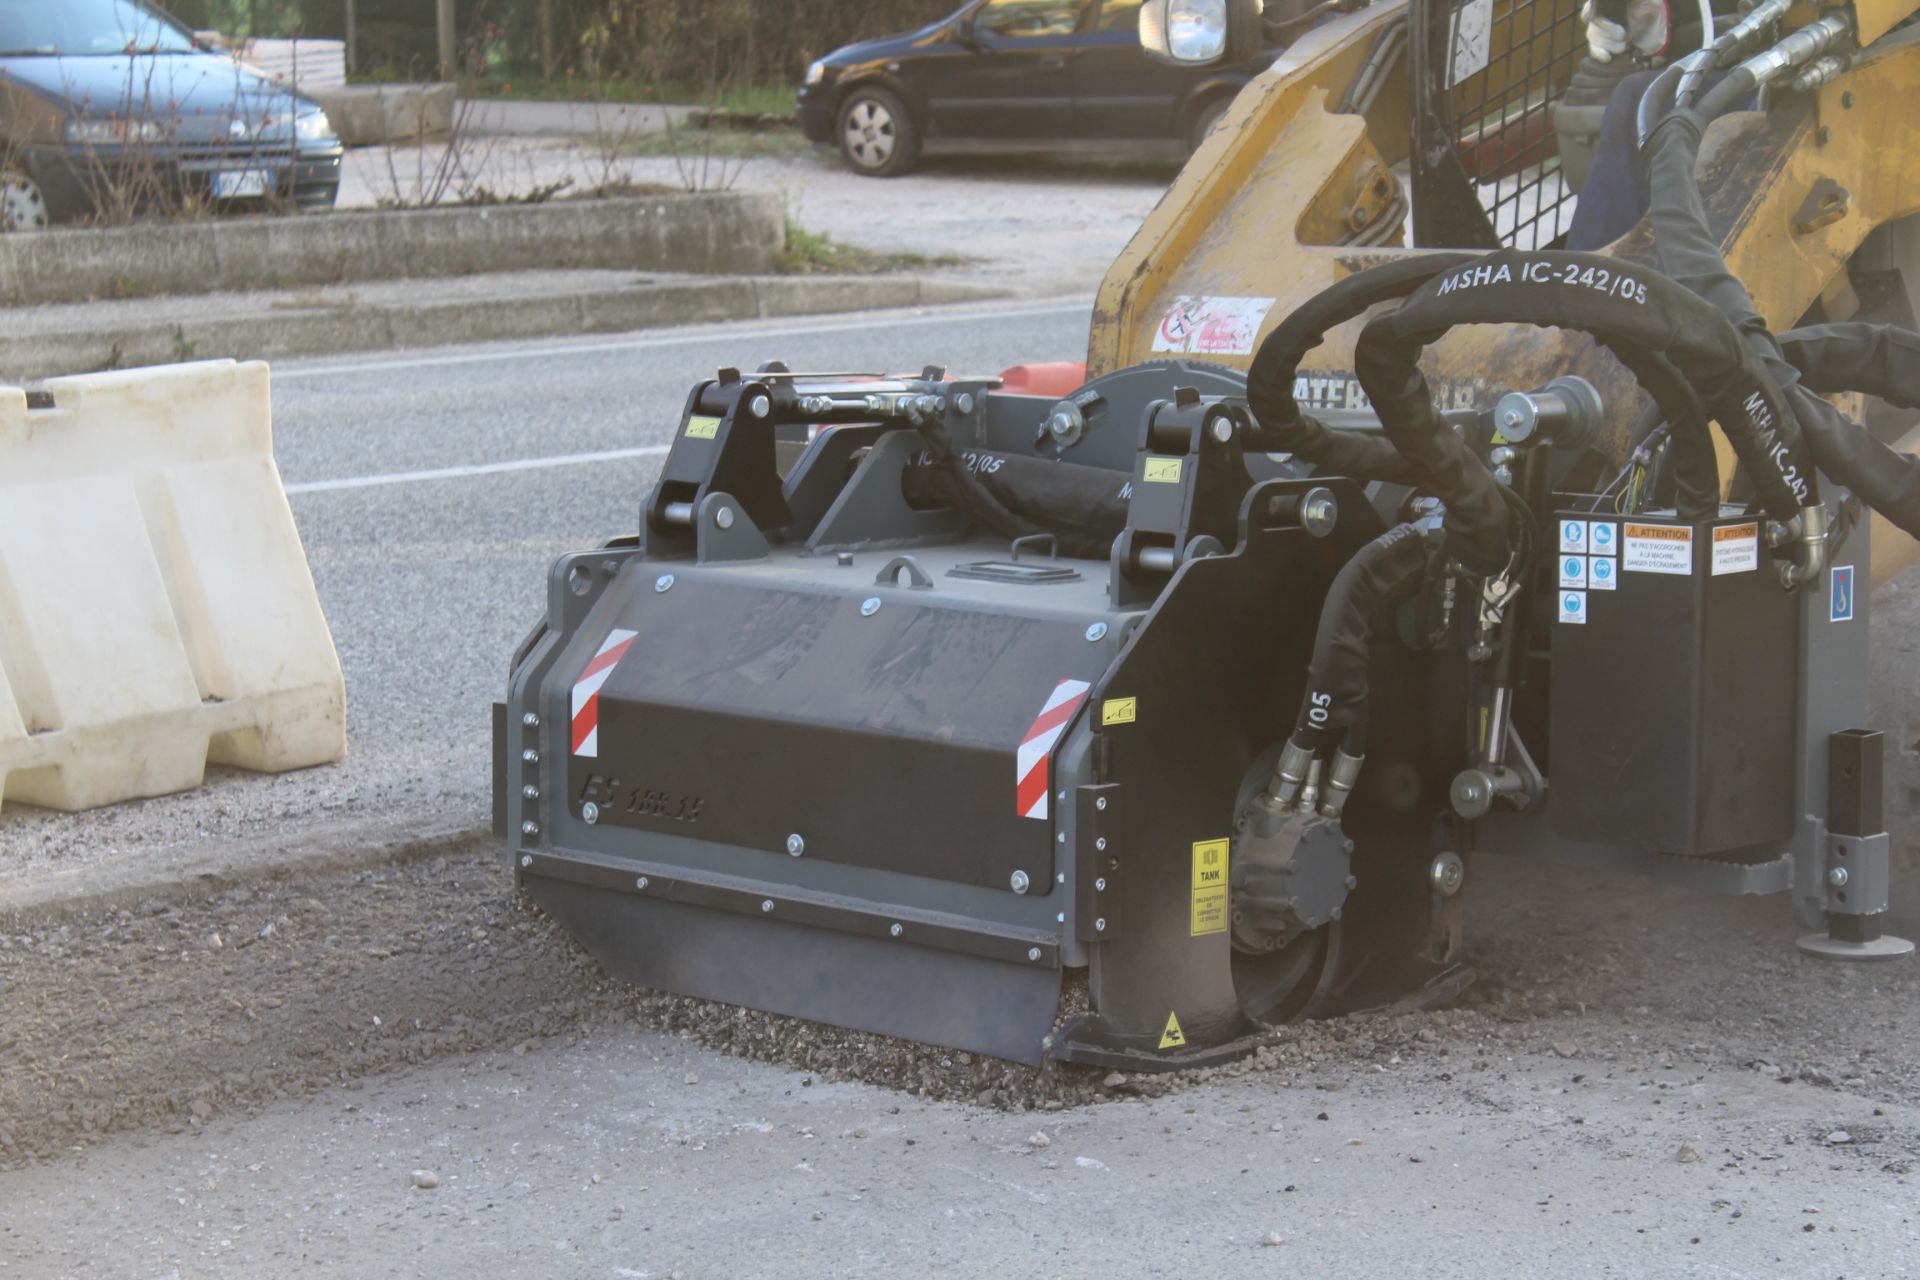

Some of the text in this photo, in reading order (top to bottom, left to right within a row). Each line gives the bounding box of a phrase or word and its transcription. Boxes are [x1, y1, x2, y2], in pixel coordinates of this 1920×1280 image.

[1437, 261, 1648, 305] MSHA IC-242/05
[1743, 390, 1777, 449] MSHA
[1640, 528, 1689, 540] ATTENTION
[1200, 870, 1220, 882] TANK
